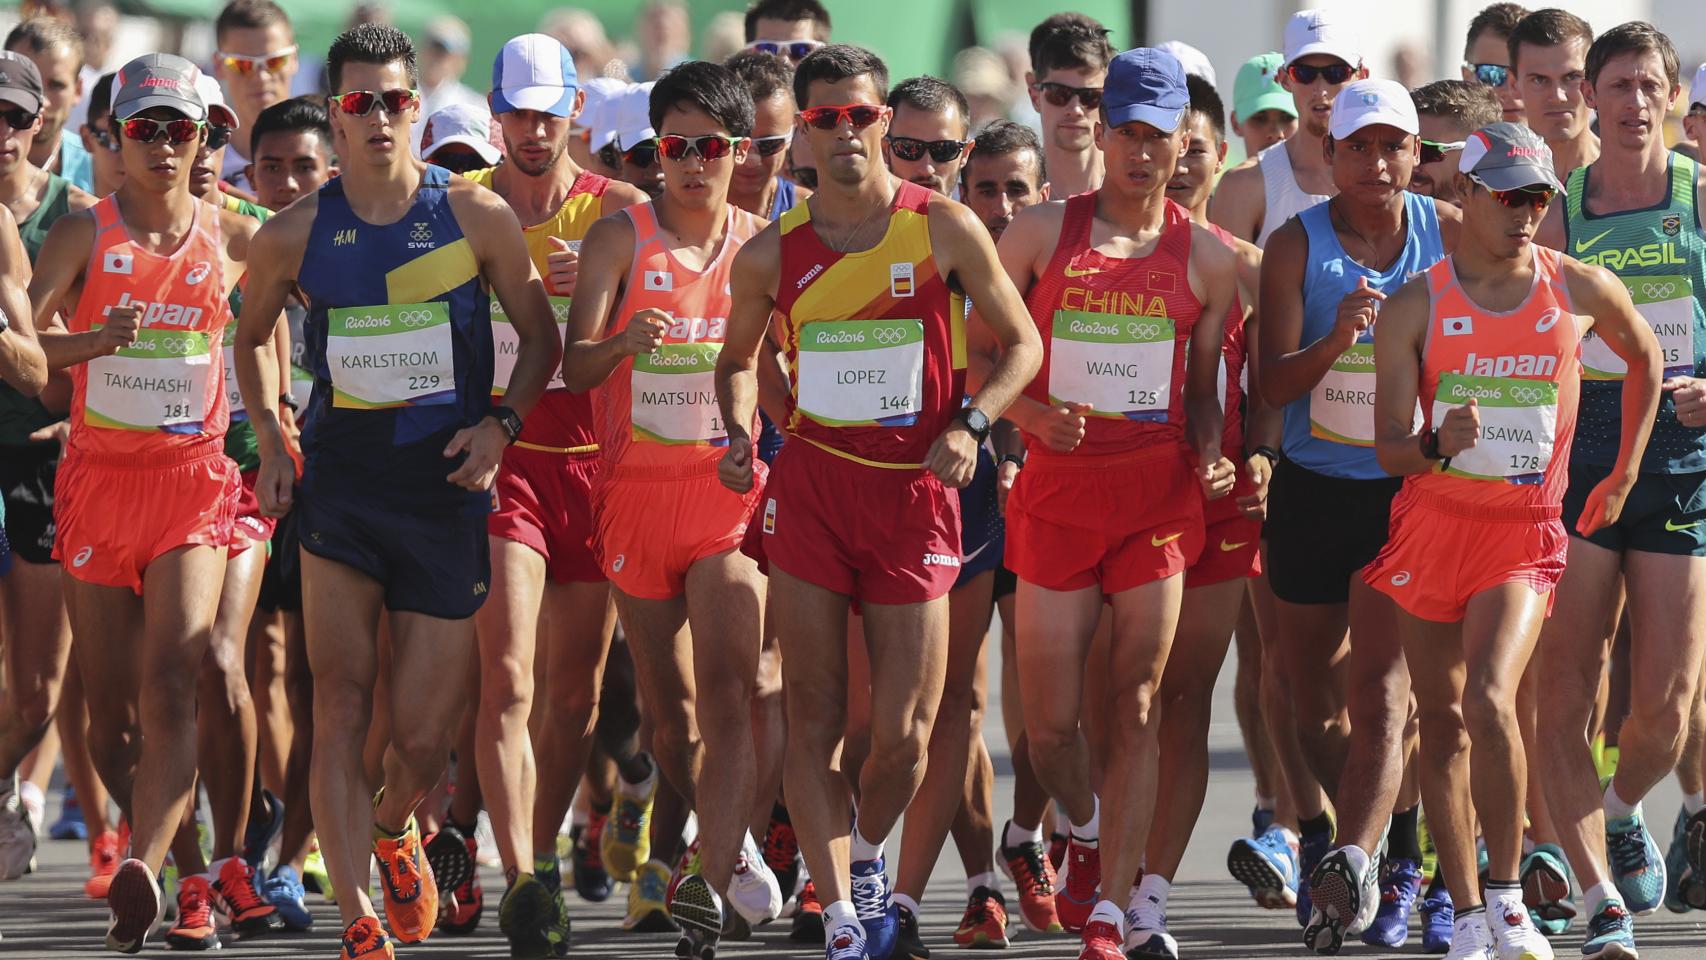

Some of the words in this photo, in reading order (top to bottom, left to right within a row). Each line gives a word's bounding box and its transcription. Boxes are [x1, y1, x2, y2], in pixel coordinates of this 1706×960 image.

[140, 76, 181, 89] Japan
[1061, 287, 1168, 318] CHINA
[345, 314, 392, 329] Rio2016
[1070, 320, 1119, 335] Rio2016
[816, 331, 865, 344] Rio2016
[341, 351, 439, 369] KARLSTROM
[650, 353, 698, 366] Rio2016
[1663, 349, 1679, 362] 15
[1086, 361, 1138, 378] WANG
[1452, 352, 1557, 377] Japan
[104, 372, 192, 393] TAKAHASHI
[408, 375, 440, 390] 229
[837, 370, 886, 384] LOPEZ
[641, 391, 720, 405] MATSUNA
[1128, 390, 1157, 405] 125
[1325, 388, 1376, 405] BARRO
[1452, 384, 1502, 399] Rio2016
[880, 396, 911, 410] 144
[163, 404, 191, 418] 181
[1482, 425, 1533, 444] ISAWA
[1510, 454, 1540, 470] 178
